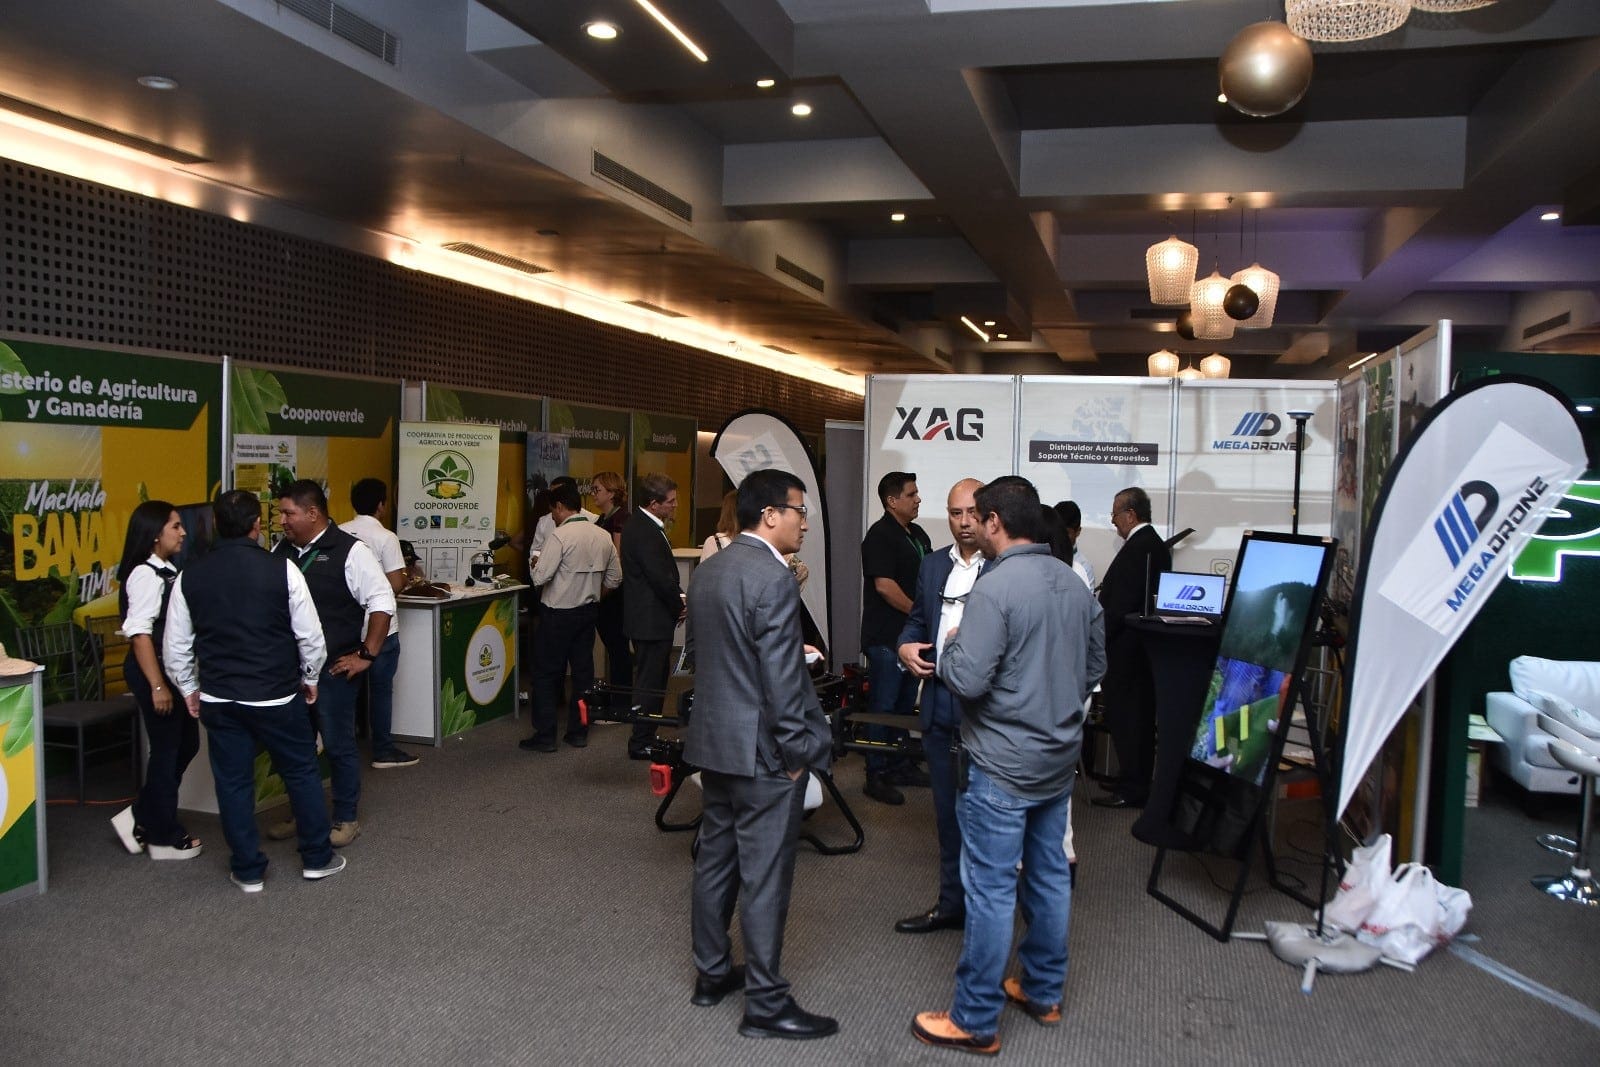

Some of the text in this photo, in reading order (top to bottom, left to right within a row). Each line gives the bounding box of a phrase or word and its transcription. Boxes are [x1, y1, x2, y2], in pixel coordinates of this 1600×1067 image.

[0, 371, 197, 404] sterio de Agricultura
[27, 397, 142, 420] y Ganadería
[280, 403, 365, 424] Cooporoverde
[894, 407, 984, 441] XAG
[1038, 452, 1068, 460] Soporte
[1070, 452, 1102, 460] Técnico
[1049, 443, 1139, 453] Distribuidor Autorizado
[24, 478, 107, 516] Machala
[414, 502, 479, 510] COOPOROVERDE
[1446, 476, 1549, 612] MEGADRONE
[1163, 602, 1215, 612] MEGADRONE
